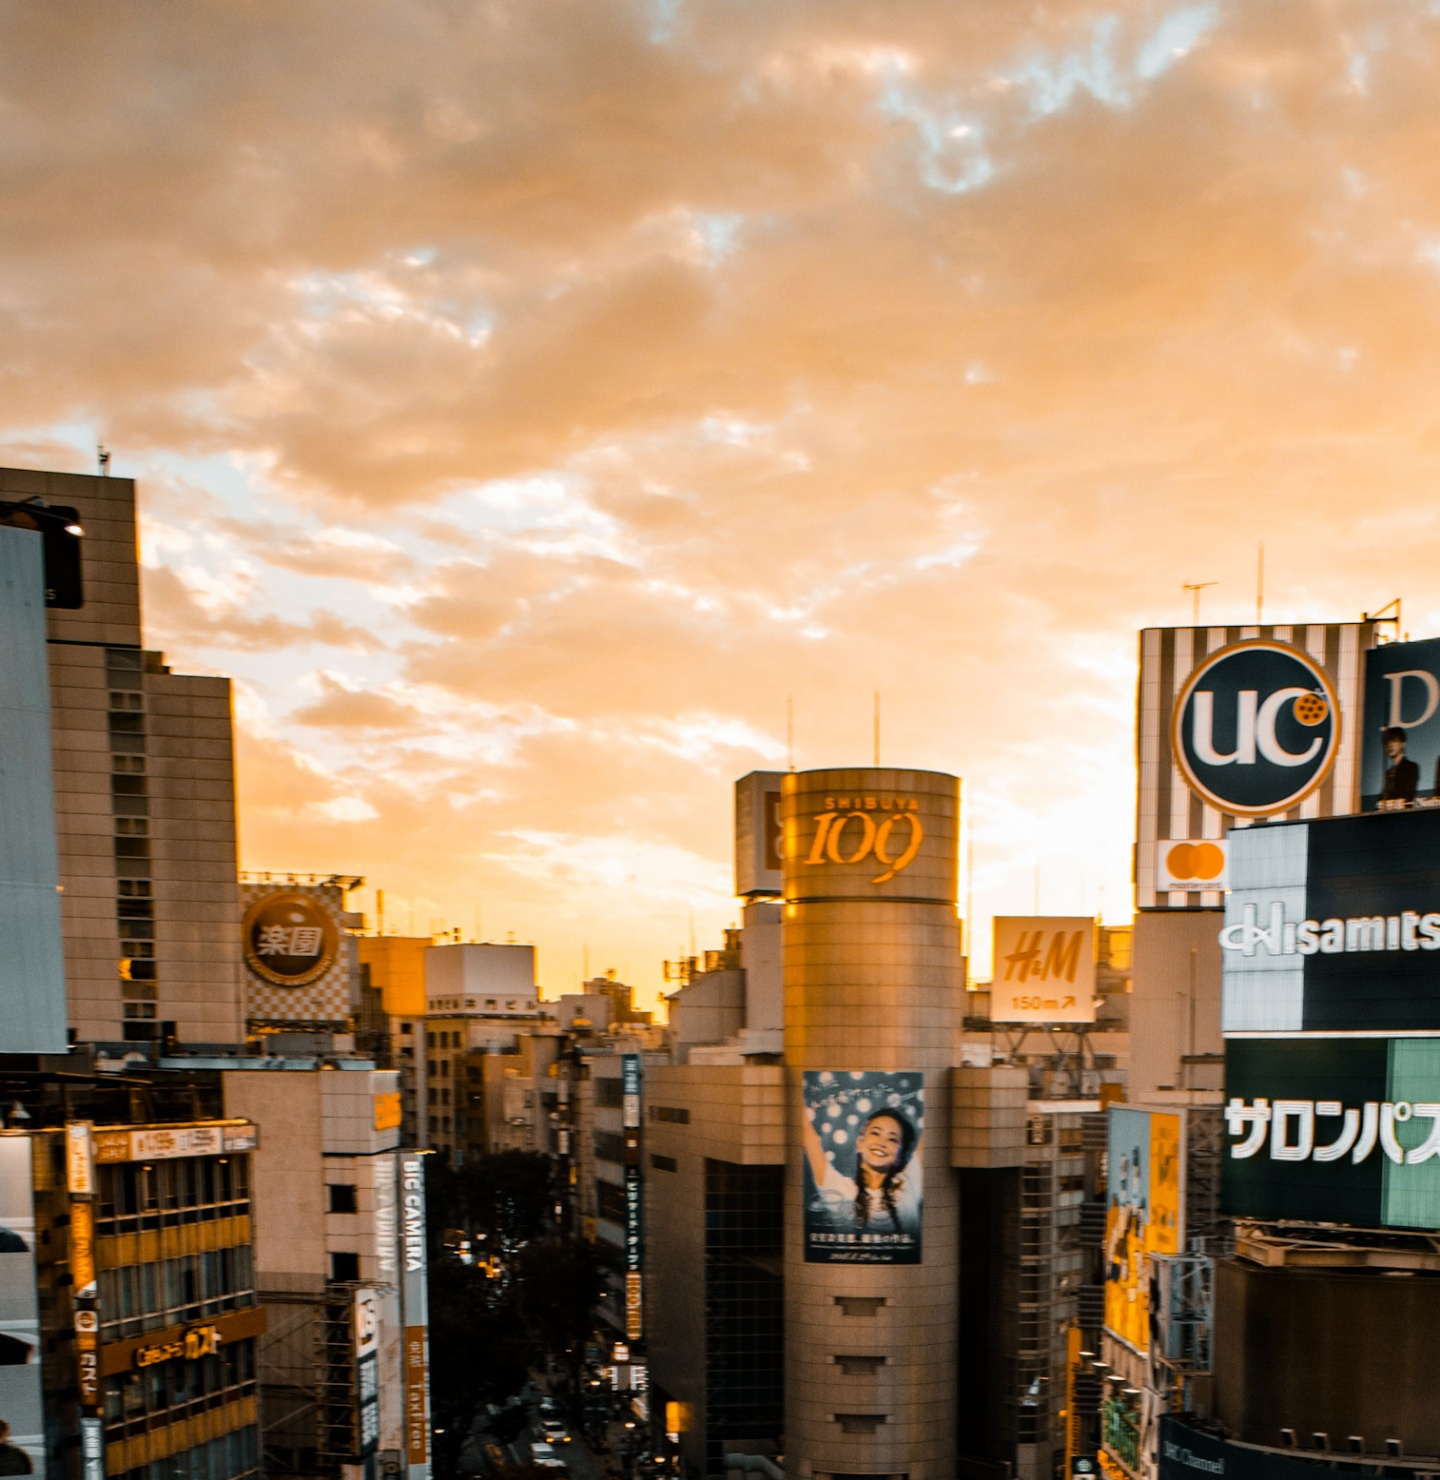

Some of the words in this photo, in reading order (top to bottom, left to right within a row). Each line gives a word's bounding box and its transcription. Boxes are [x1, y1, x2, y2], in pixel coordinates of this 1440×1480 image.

[824, 796, 920, 811] SHIBUYA
[803, 811, 924, 884] 109
[257, 925, 323, 956] 楽園
[1003, 929, 1085, 983] H&M
[1011, 996, 1060, 1010] 150m
[402, 1161, 421, 1191] BIC
[404, 1194, 423, 1272] CAMERA
[80, 1351, 98, 1397] ガスト
[1182, 1448, 1225, 1475] Channel
